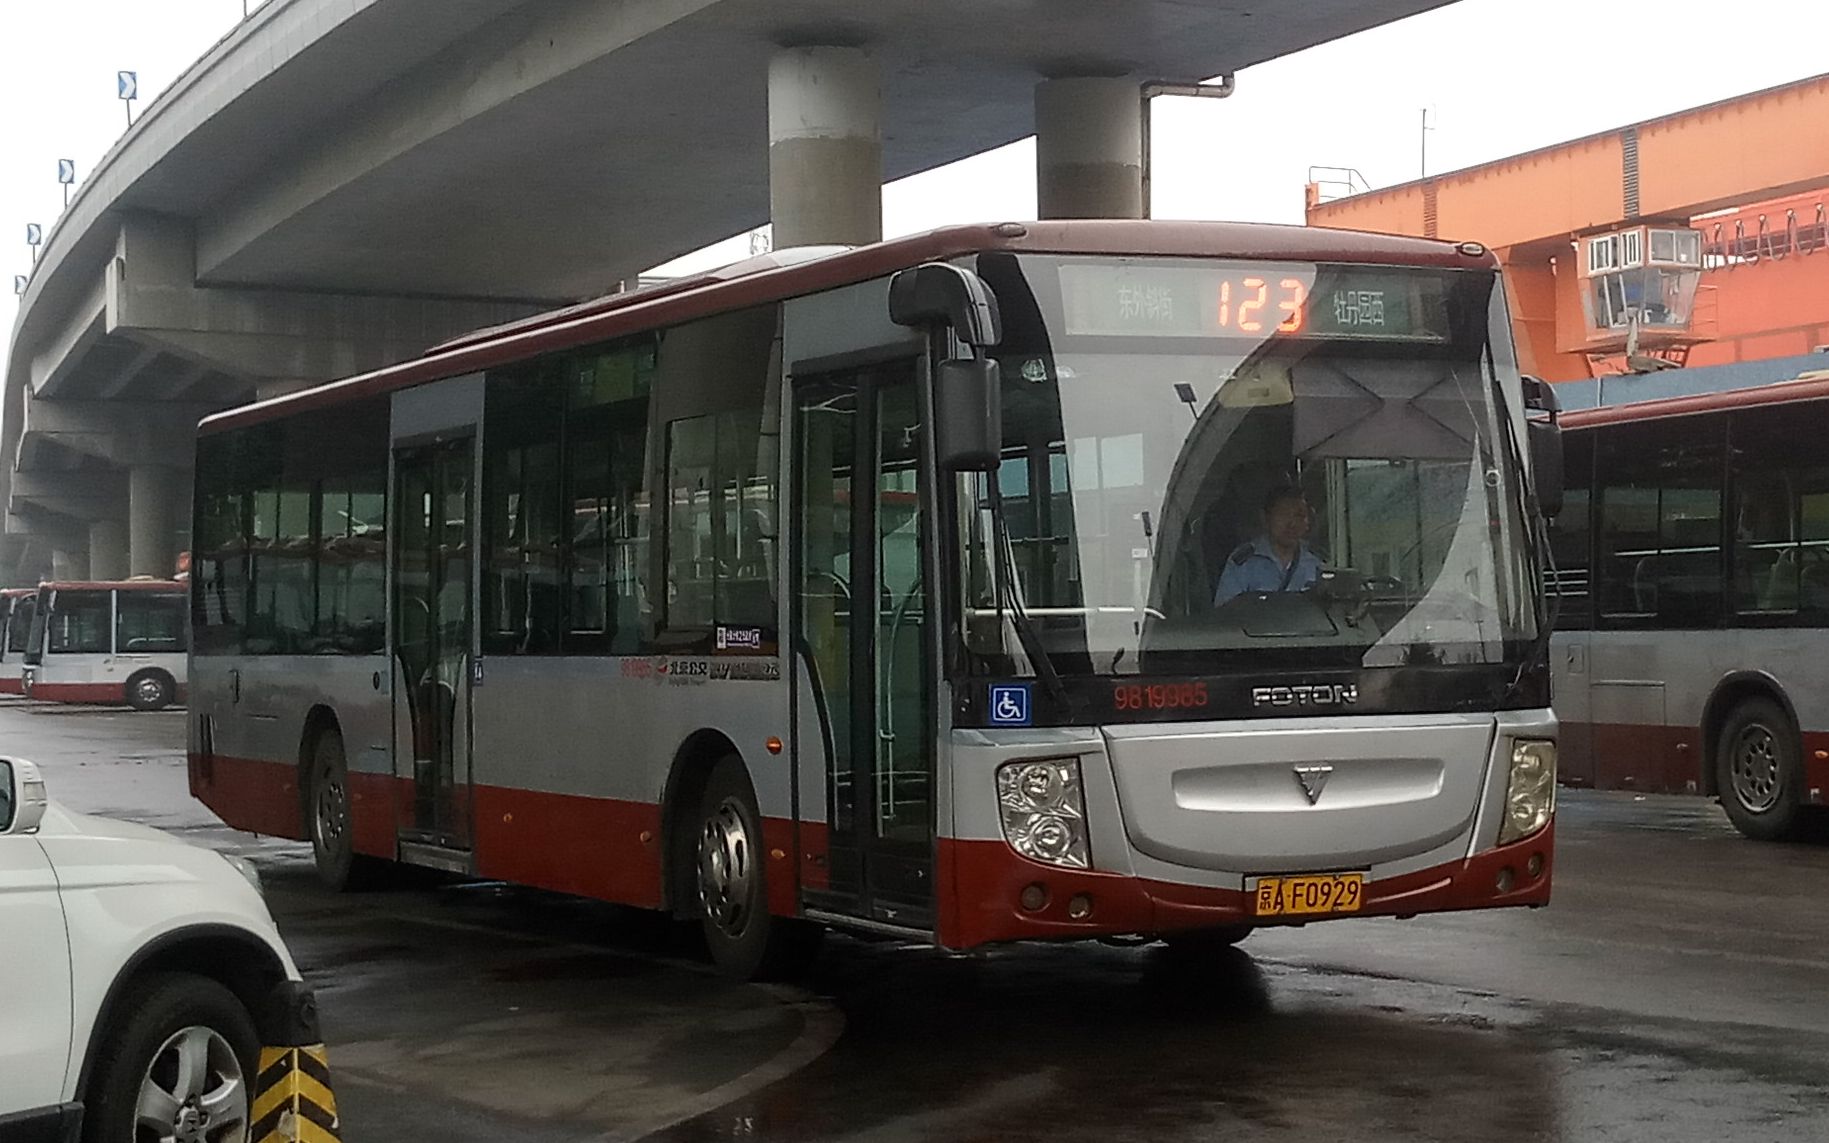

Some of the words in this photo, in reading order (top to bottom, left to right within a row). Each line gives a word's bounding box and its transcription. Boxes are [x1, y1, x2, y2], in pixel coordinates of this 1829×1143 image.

[1218, 278, 1304, 332] 123
[1334, 290, 1384, 326] 牡丹园西
[1252, 684, 1358, 706] FOTON
